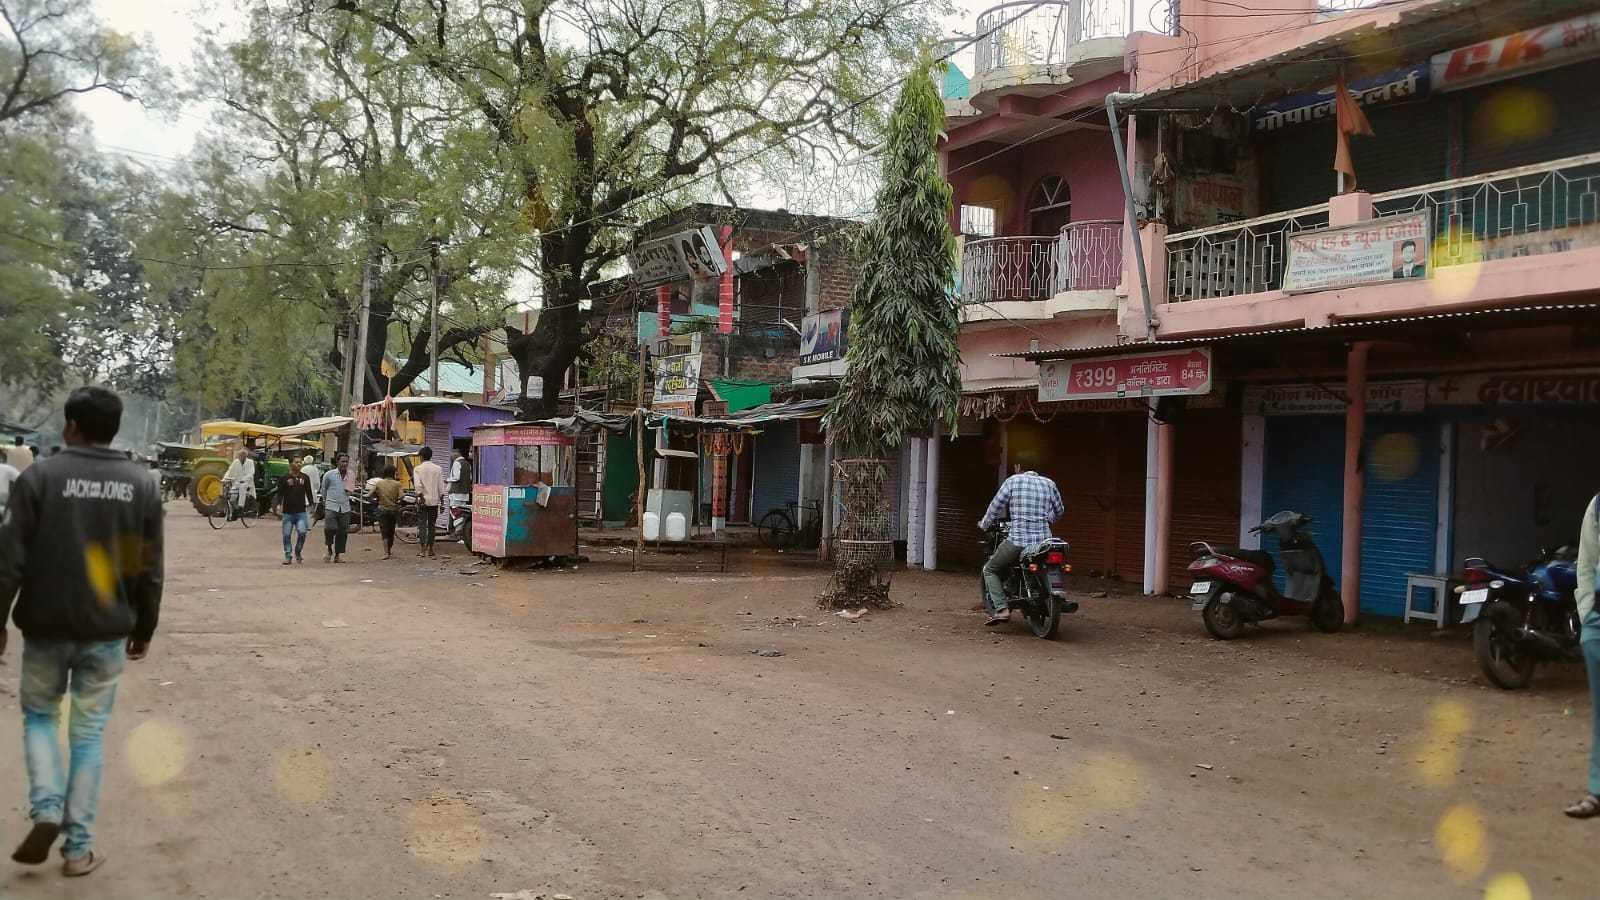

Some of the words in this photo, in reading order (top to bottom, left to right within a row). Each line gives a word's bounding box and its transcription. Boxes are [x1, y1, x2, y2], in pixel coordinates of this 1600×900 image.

[812, 350, 834, 360] MOBILE
[1075, 366, 1117, 388] ₹399
[1155, 375, 1172, 385] डाटा
[1181, 369, 1194, 380] 84
[1477, 374, 1600, 405] दवाखा
[62, 478, 91, 499] JACK
[101, 481, 134, 502] JONES
